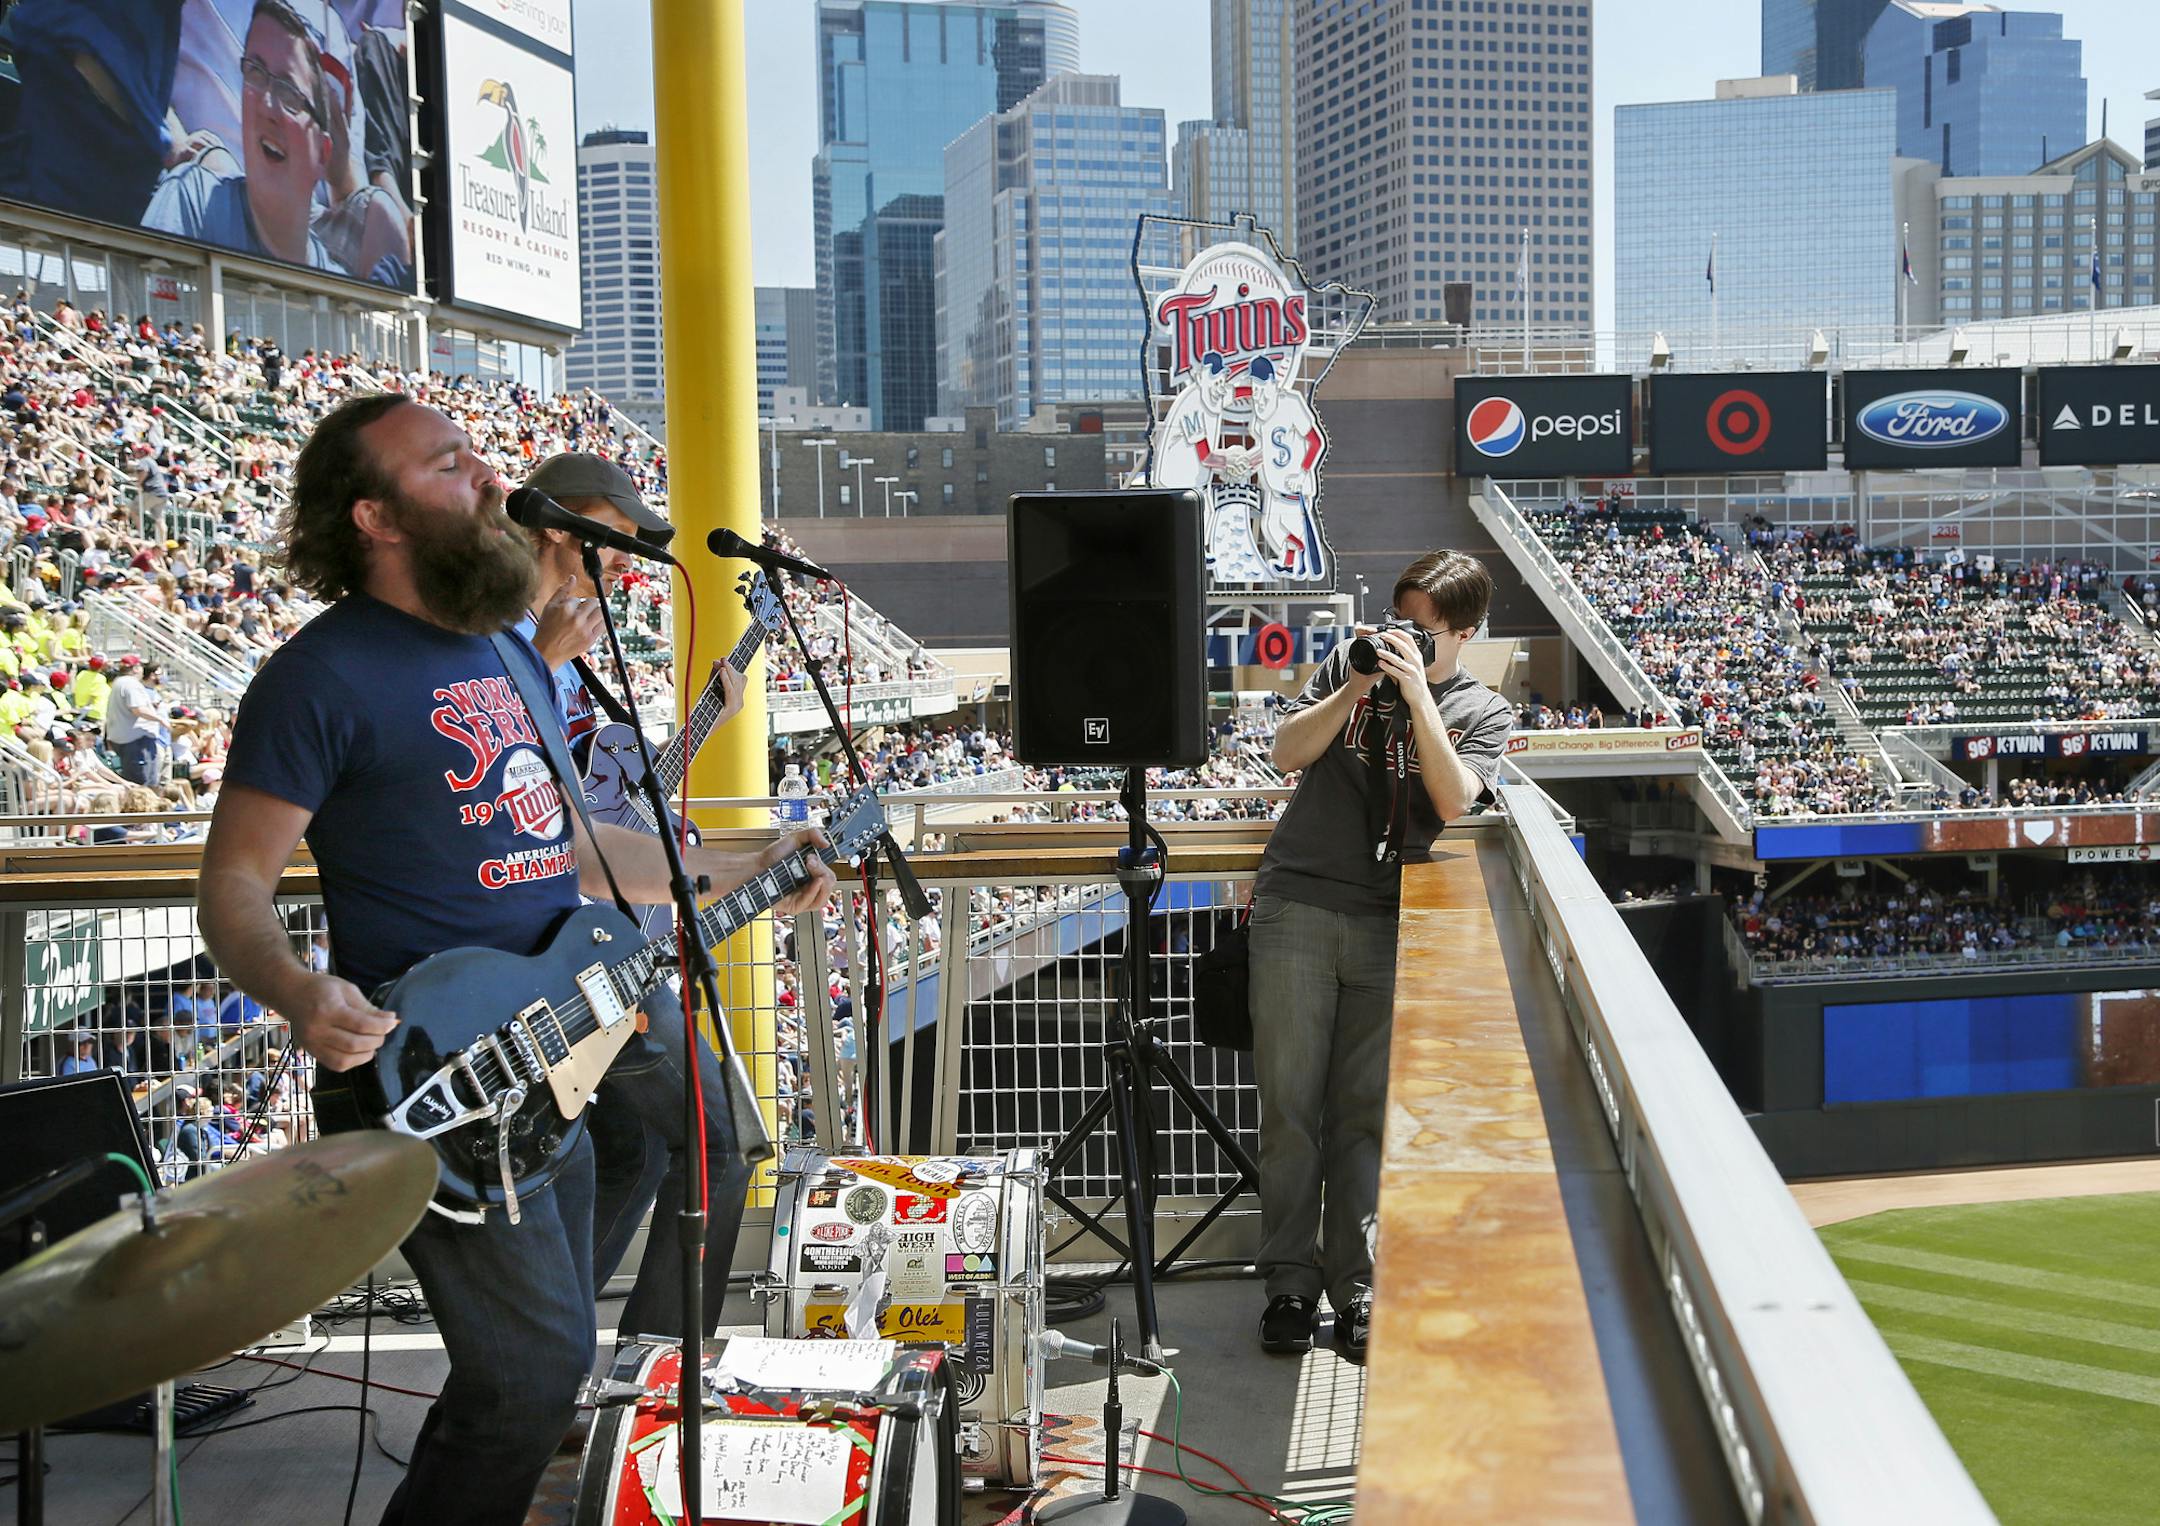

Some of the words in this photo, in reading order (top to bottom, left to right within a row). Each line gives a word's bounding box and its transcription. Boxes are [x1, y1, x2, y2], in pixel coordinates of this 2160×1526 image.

[459, 163, 517, 223] Treasure
[529, 189, 568, 239] Island
[463, 220, 507, 242] RESORT
[514, 236, 521, 246] &
[527, 240, 569, 261] CASINO
[486, 252, 503, 265] RED
[1158, 283, 1308, 376] Twins
[1183, 411, 1202, 435] M
[1532, 409, 1621, 441] pepsi
[1887, 400, 1978, 437] Ford
[1271, 426, 1292, 468] S
[1936, 525, 1960, 536] 238
[433, 676, 523, 717] WORL
[1532, 741, 1556, 750] Small
[1599, 740, 1613, 751] Big
[1615, 739, 1660, 750] Difference.
[1667, 733, 1698, 751] GLAD
[1397, 741, 1406, 779] Canon
[460, 801, 495, 826] 19
[505, 843, 560, 863] AMERICAN
[2074, 848, 2135, 860] POWER
[842, 1159, 890, 1176] Twin
[898, 1171, 951, 1196] Town
[898, 1232, 935, 1242] HIGH
[899, 1307, 944, 1328] Ole's
[974, 1303, 991, 1371] LULLWATER
